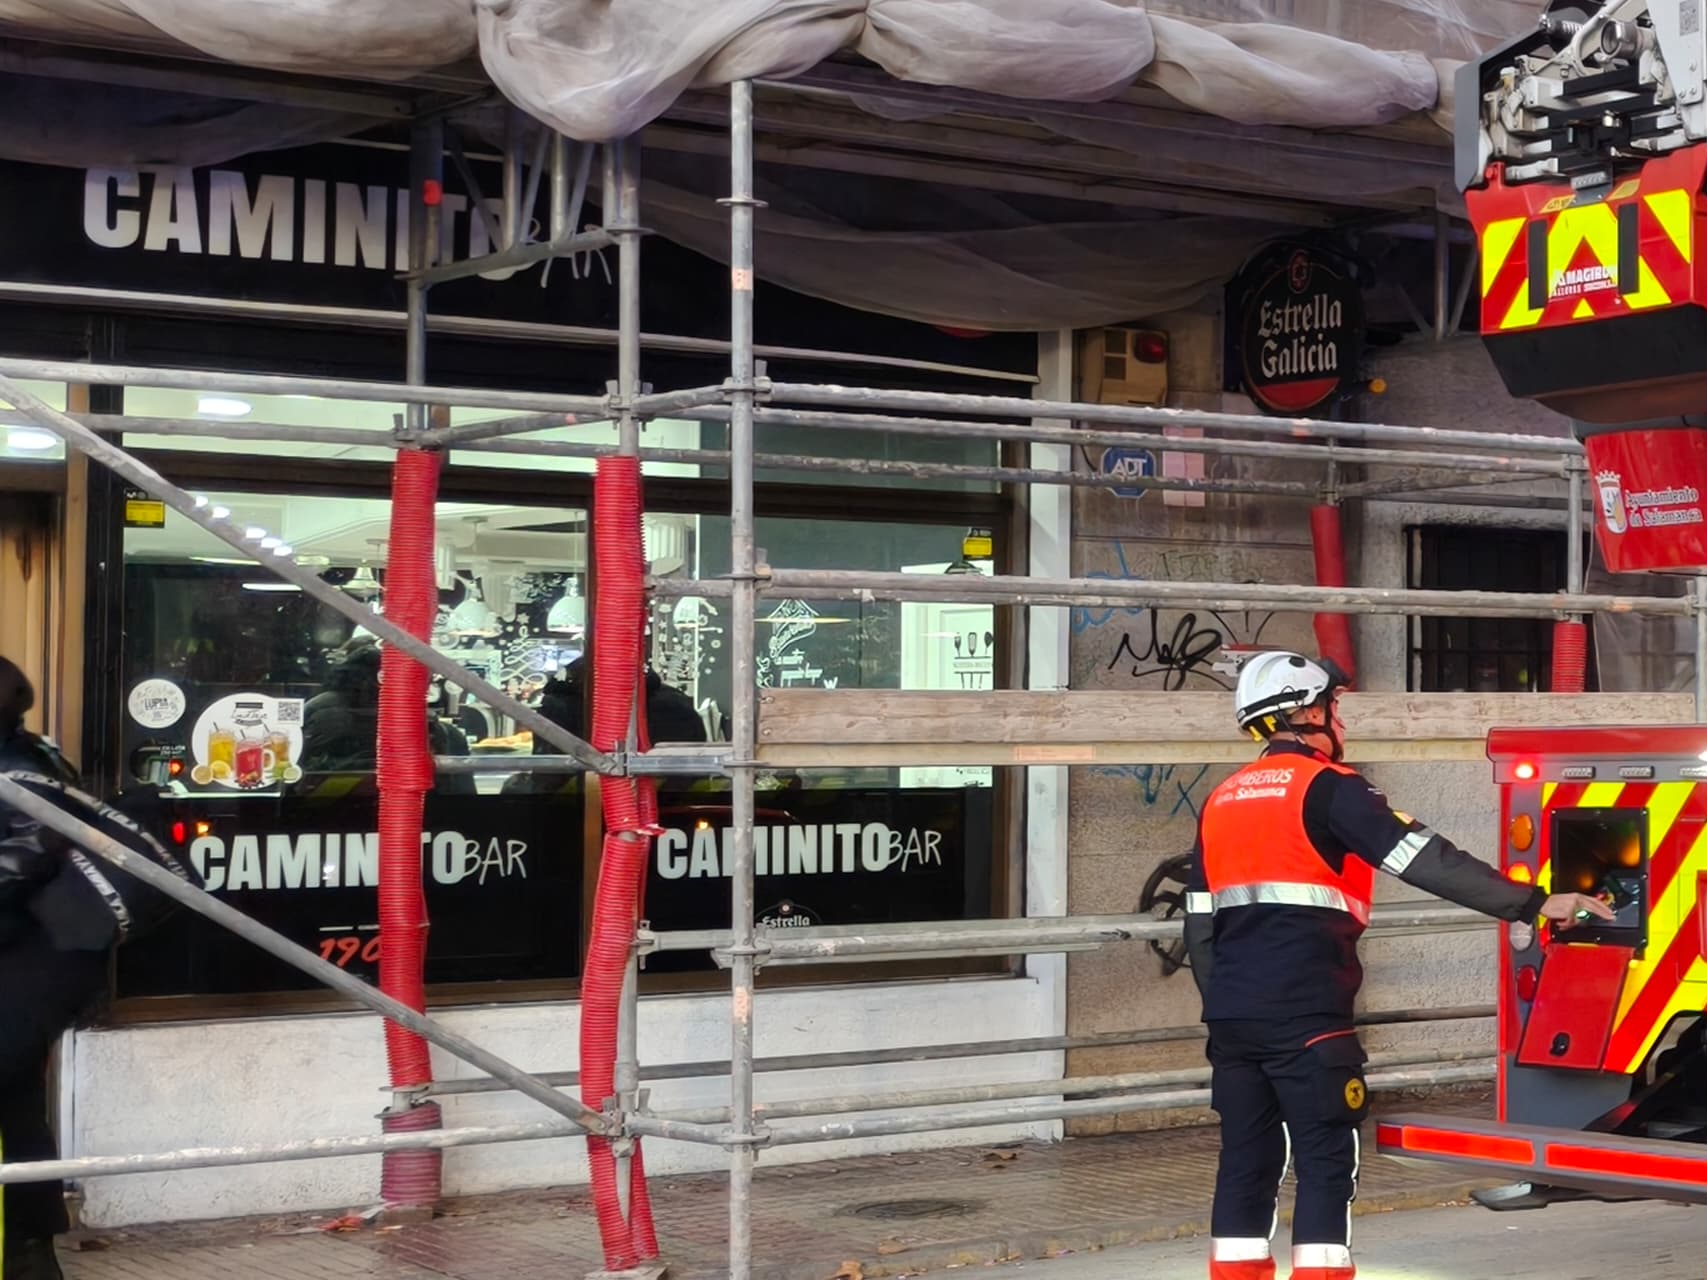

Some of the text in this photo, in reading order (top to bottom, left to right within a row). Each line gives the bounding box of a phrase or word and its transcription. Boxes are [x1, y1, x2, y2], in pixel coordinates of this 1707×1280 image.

[1257, 293, 1342, 338] Estrella
[1260, 333, 1338, 379] Galicia
[1110, 457, 1147, 479] ADT
[190, 830, 528, 892] CAMINTO BAR
[656, 822, 942, 880] CAMINITO BAR
